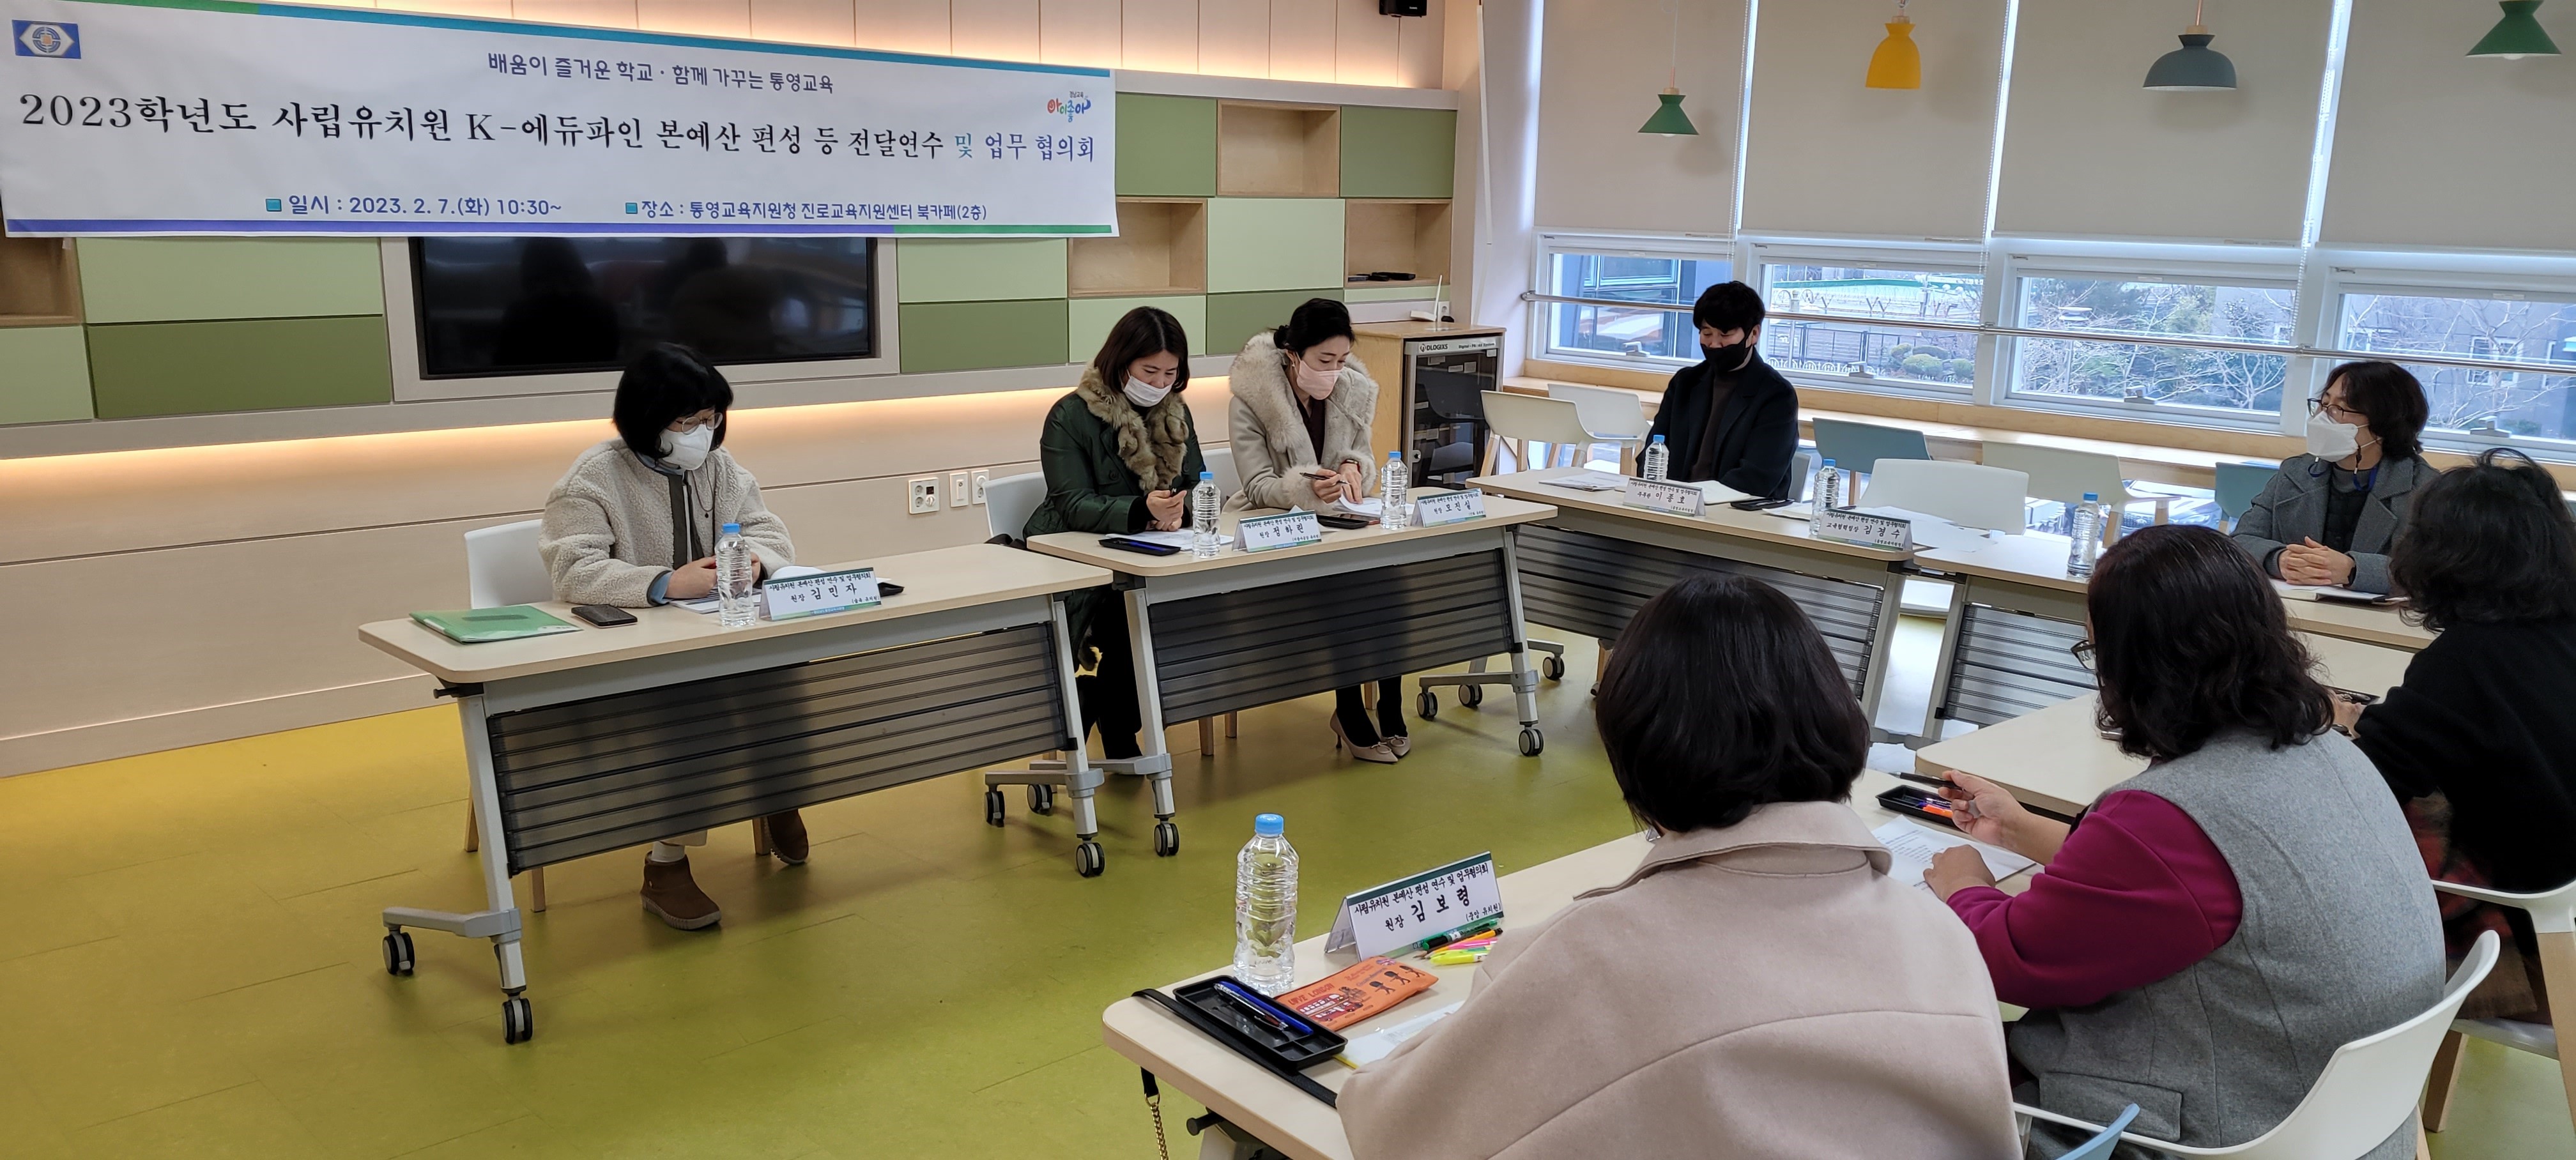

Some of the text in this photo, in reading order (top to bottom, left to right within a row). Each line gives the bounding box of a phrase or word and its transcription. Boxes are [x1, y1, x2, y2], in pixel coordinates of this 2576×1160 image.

[488, 52, 547, 76] 배움이
[555, 57, 611, 80] 즐거운
[616, 61, 653, 82] 학교
[671, 65, 707, 86] 함께
[712, 68, 763, 89] 가꾸는
[769, 72, 833, 94] 통영교육
[1047, 98, 1091, 123] 아이좋아
[20, 94, 257, 133] 2023학년도
[272, 102, 451, 141] 사립유치원
[656, 119, 741, 151] 본예산
[752, 124, 800, 155] 편성
[814, 127, 839, 155] 등
[848, 128, 944, 159] 전달연수
[954, 132, 972, 158] 및
[985, 132, 1027, 160] 업무
[1035, 134, 1093, 162] 협의회
[289, 195, 329, 215] 일시
[349, 197, 407, 214] 2023.
[641, 201, 674, 218] 장소
[689, 201, 796, 220] 통영교육지원청
[801, 202, 912, 220] 진로교육지원센터
[917, 204, 986, 221] 북카페(2층)
[791, 593, 805, 603] 원장
[1354, 862, 1489, 916] 사립유치원 본예산 편성 연수 및 업무협의회
[1385, 915, 1404, 932] 원장
[1308, 983, 1335, 998] LONDON
